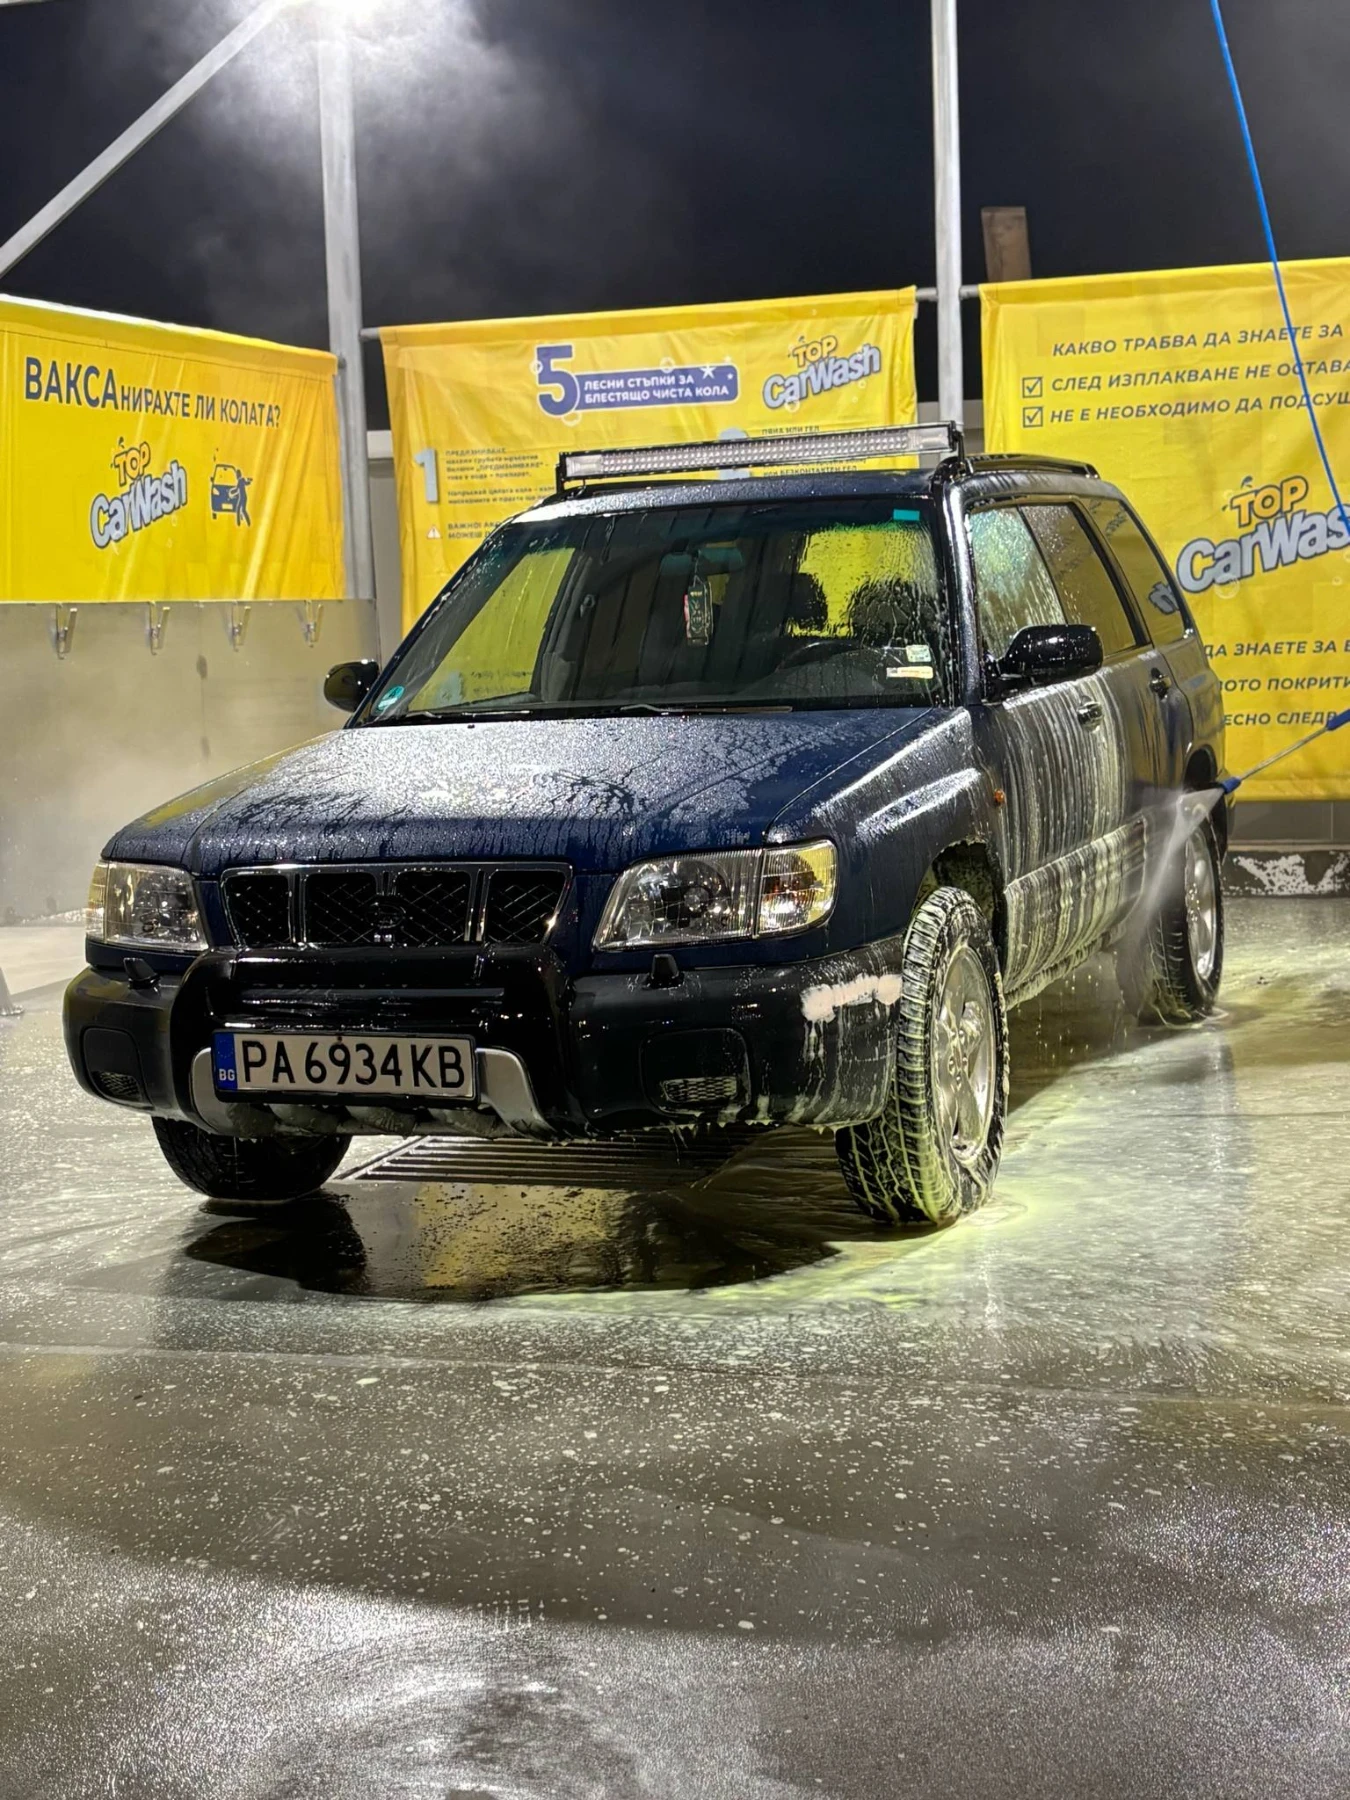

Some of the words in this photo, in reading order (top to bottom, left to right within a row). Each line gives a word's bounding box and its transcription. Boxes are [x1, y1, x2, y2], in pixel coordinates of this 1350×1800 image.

[792, 335, 838, 368] TOP
[1052, 339, 1117, 357] КАКВО
[1123, 334, 1198, 352] ТРАБВА
[1202, 331, 1232, 348] ДА
[1237, 325, 1314, 343] ЗНАЕТЕ
[1318, 323, 1344, 339] ЗА
[535, 343, 579, 418] 5
[583, 378, 625, 391] ЛЕСНИ
[626, 375, 676, 389] СТЪПКИ
[678, 373, 695, 386] ЗА
[762, 343, 882, 410] CarWash
[1051, 375, 1102, 392] СЛЕД
[1108, 366, 1240, 388] ИЗПЛАКВАНЕ
[1245, 364, 1272, 379] НЕ
[194, 394, 215, 421] ЛИ
[219, 397, 282, 428] КОЛАТА?
[584, 388, 651, 404] БЛЕСТЯЩО
[652, 387, 693, 400] ЧИСТА
[694, 384, 730, 398] КОЛА
[1050, 408, 1075, 423] НЕ
[1080, 407, 1091, 421] Е
[1096, 399, 1231, 420] НЕОБХОДИМО
[1234, 397, 1263, 413] ДА
[114, 441, 151, 487] TOP
[414, 447, 439, 504] 1
[90, 459, 188, 550] CarWash
[1230, 475, 1309, 529] TOP
[1233, 641, 1308, 656] ЗНАЕТЕ
[1312, 639, 1337, 654] ЗА
[218, 1068, 236, 1081] BG
